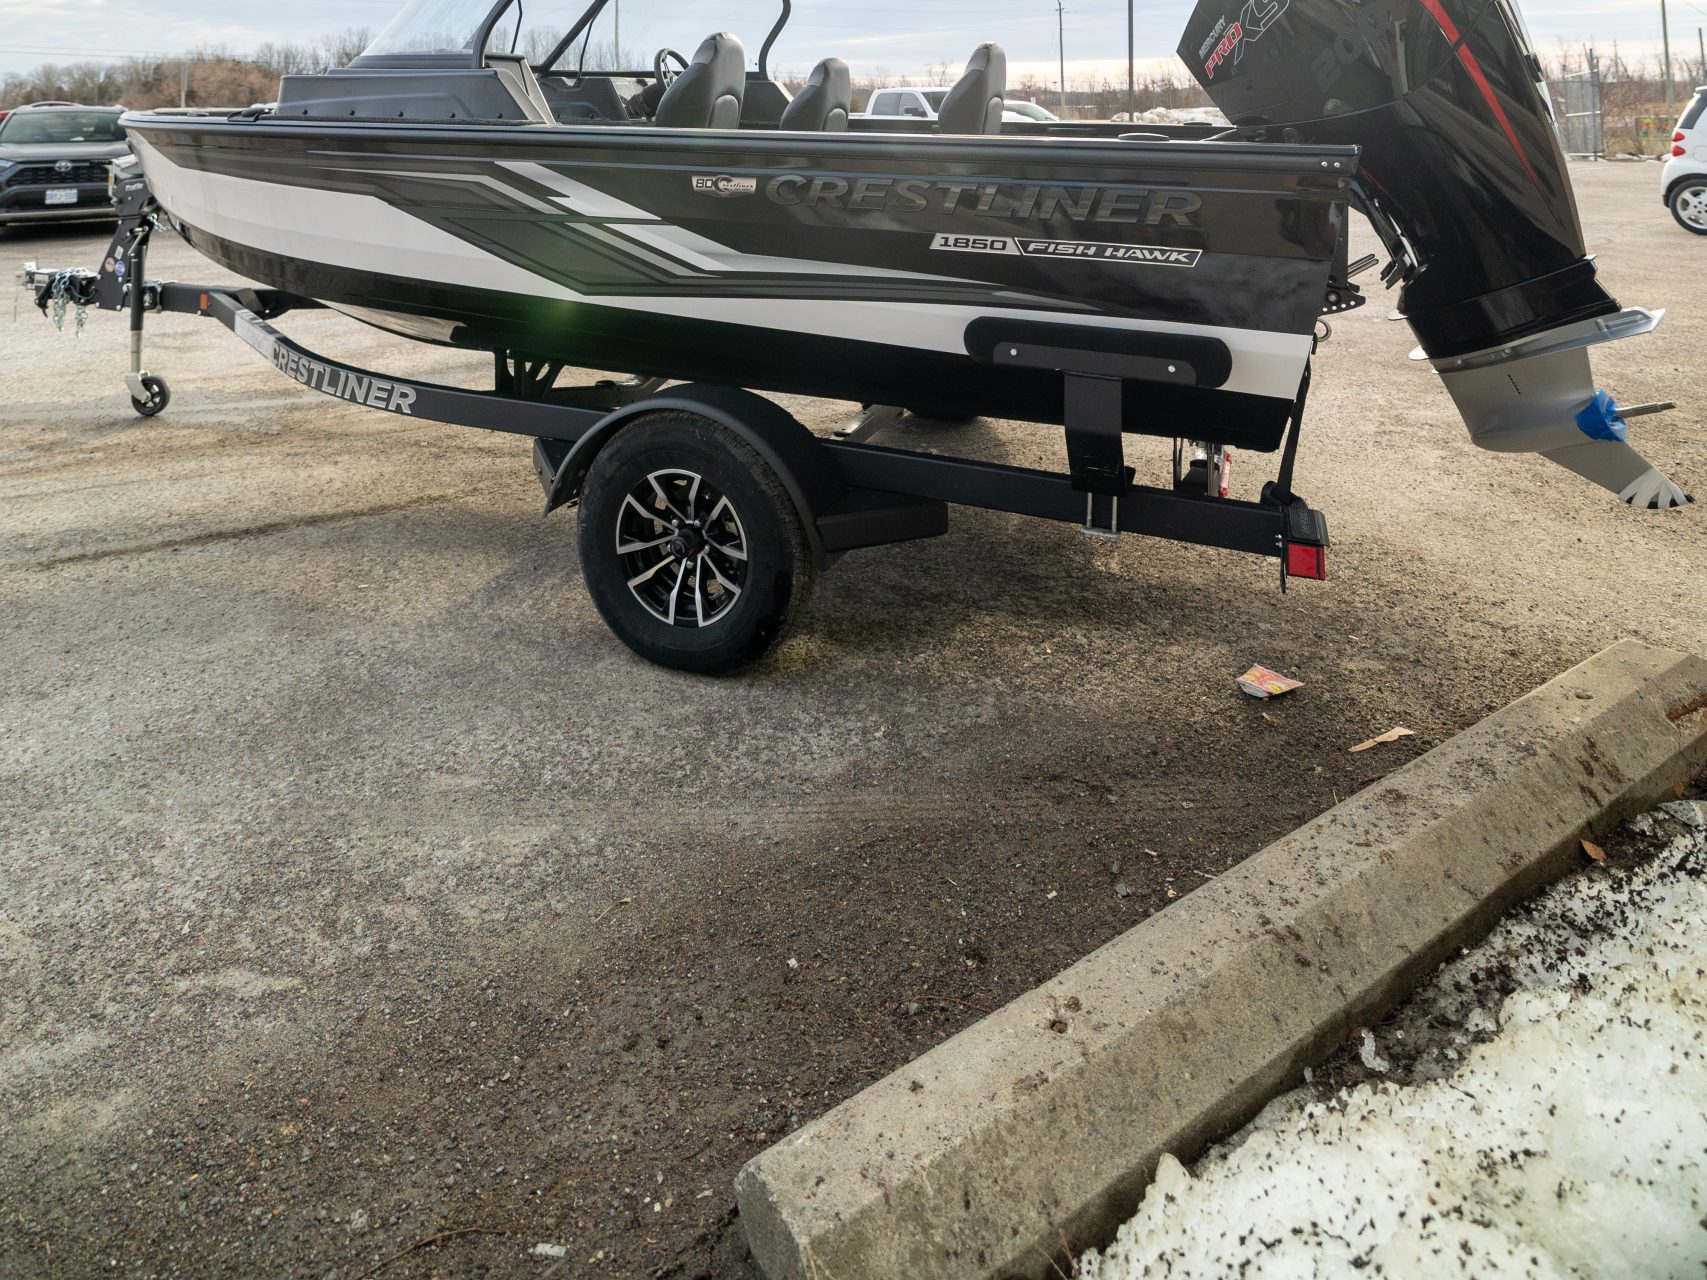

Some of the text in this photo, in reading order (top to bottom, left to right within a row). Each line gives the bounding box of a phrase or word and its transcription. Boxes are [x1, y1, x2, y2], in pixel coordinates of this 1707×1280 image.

[1199, 15, 1226, 60] MERCURY
[1205, 22, 1242, 79] PRO
[766, 175, 1202, 226] CRESTLINER
[940, 236, 1007, 251] 1850
[272, 242, 1192, 414] FISH HAWK CRESTLINER
